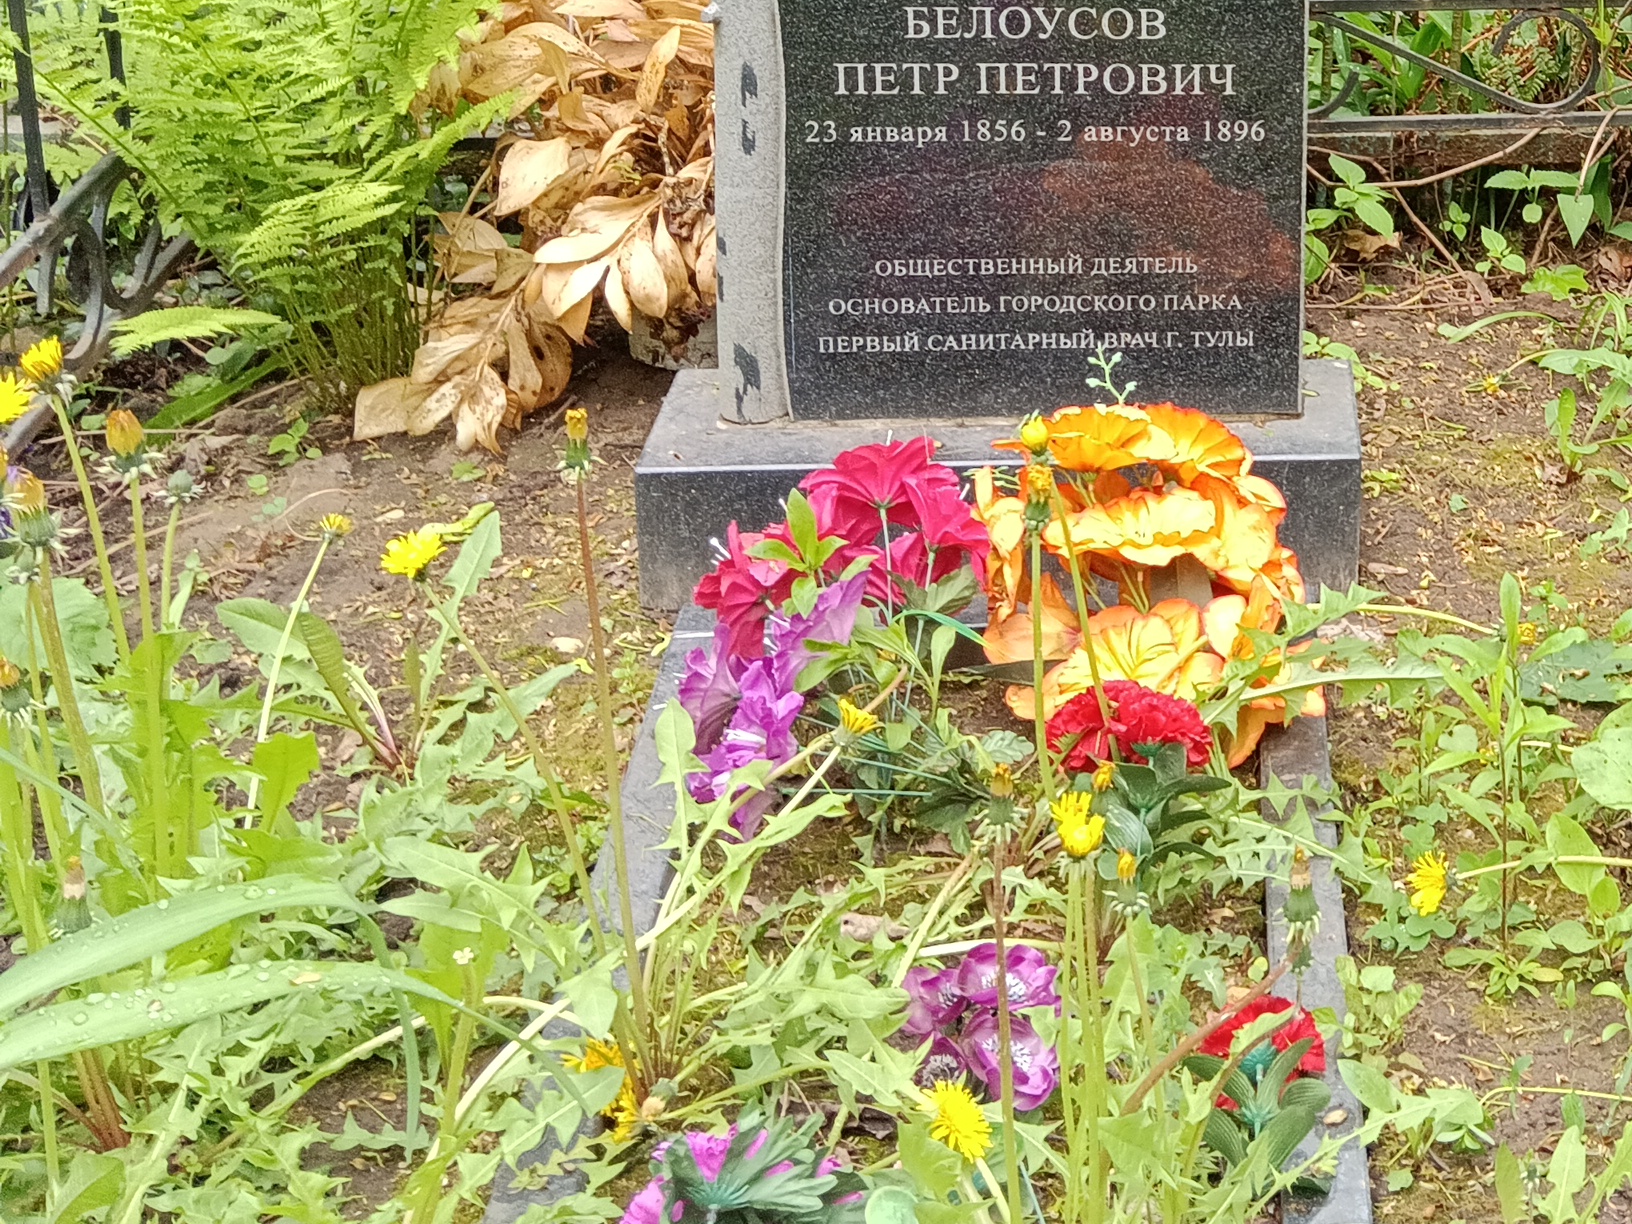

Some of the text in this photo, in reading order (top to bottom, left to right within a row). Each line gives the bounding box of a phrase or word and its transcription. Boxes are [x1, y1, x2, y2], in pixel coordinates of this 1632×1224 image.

[903, 6, 1167, 40] БЕЛОУСОВ
[833, 63, 1236, 96] ПЕТР ПЕТРОВИЧ
[804, 120, 838, 143] 23
[850, 125, 948, 148] января
[961, 119, 1026, 143] 1856
[1057, 119, 1073, 142] 2
[1083, 125, 1190, 147] августа
[1203, 119, 1266, 143] 1896
[875, 254, 1199, 278] ОБЩЕСТВЕННЫЙ ДЕЯТЕЛЬ
[828, 294, 1244, 315] ОСНОВАТЕЛЬ ГОРОДСКОГО ПАРКА
[818, 328, 1254, 353] ПЕРВЫЙ САНИТАРНЫЙ ВРАЧ Г. ТУЛЫ
